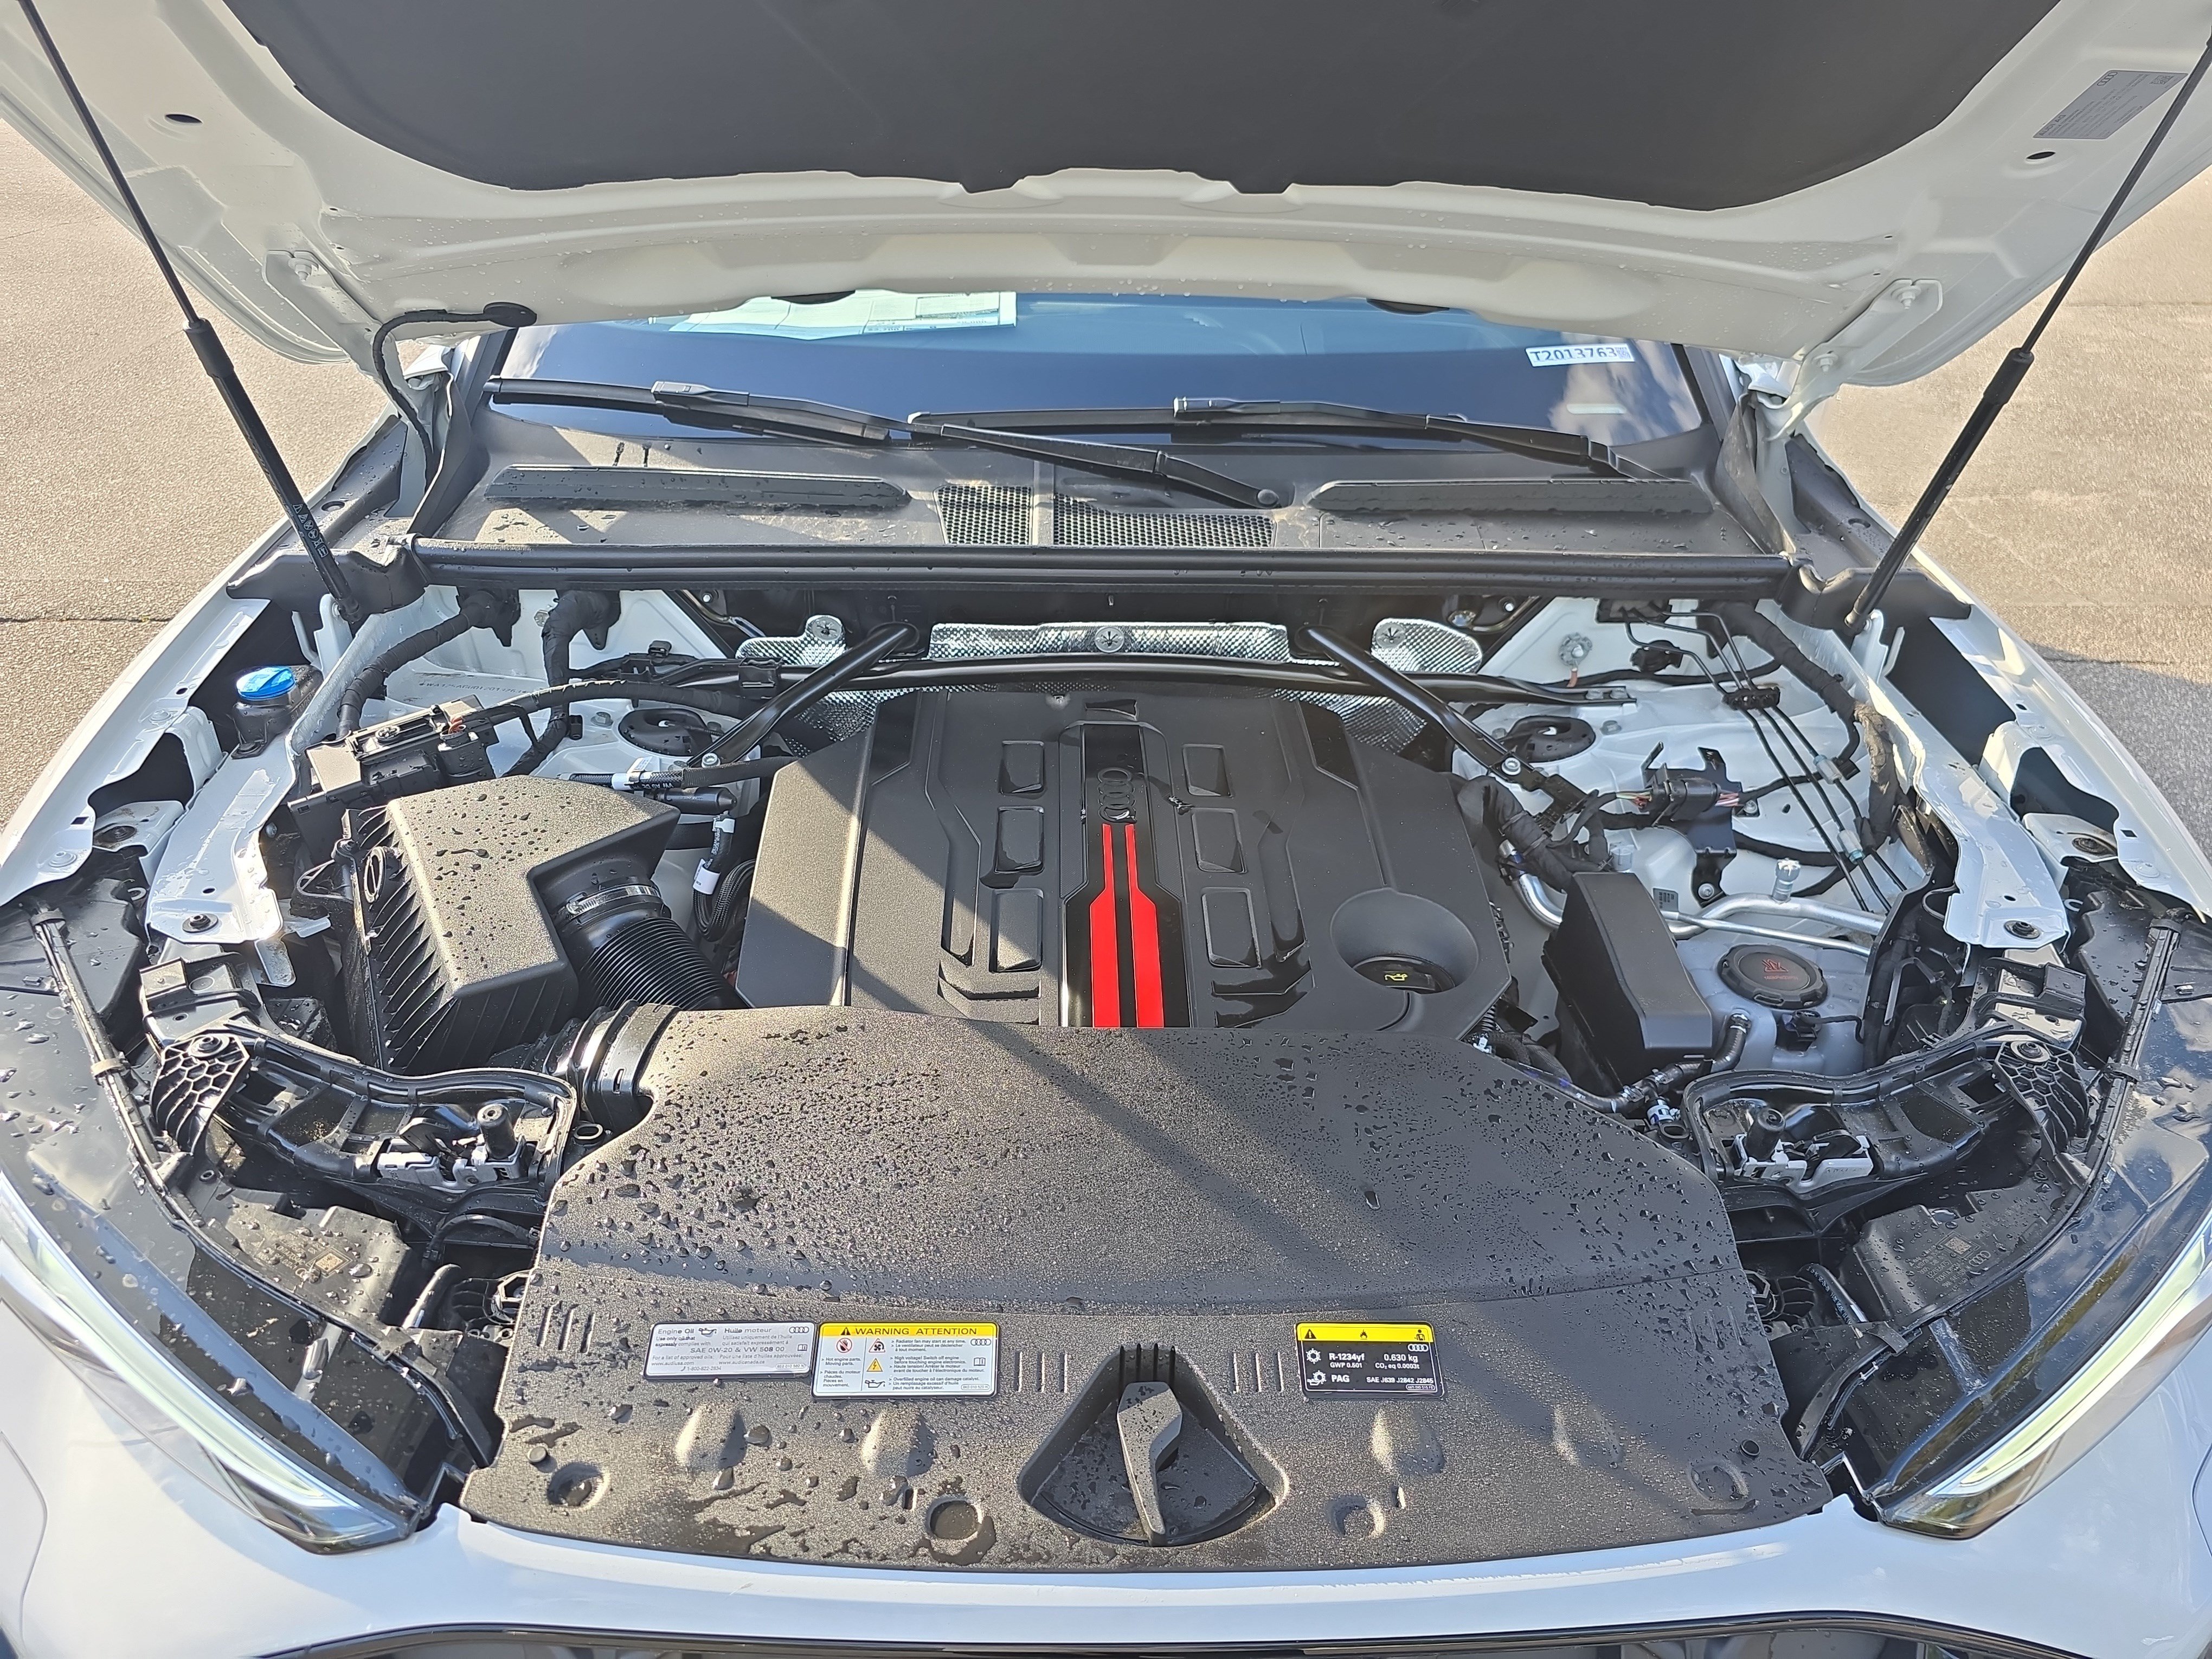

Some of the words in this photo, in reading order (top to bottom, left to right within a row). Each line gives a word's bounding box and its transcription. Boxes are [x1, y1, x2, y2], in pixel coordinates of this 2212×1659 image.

[1529, 346, 1618, 362] T2013763
[1329, 1353, 1365, 1362] R-1234yf
[1409, 1354, 1418, 1362] kg
